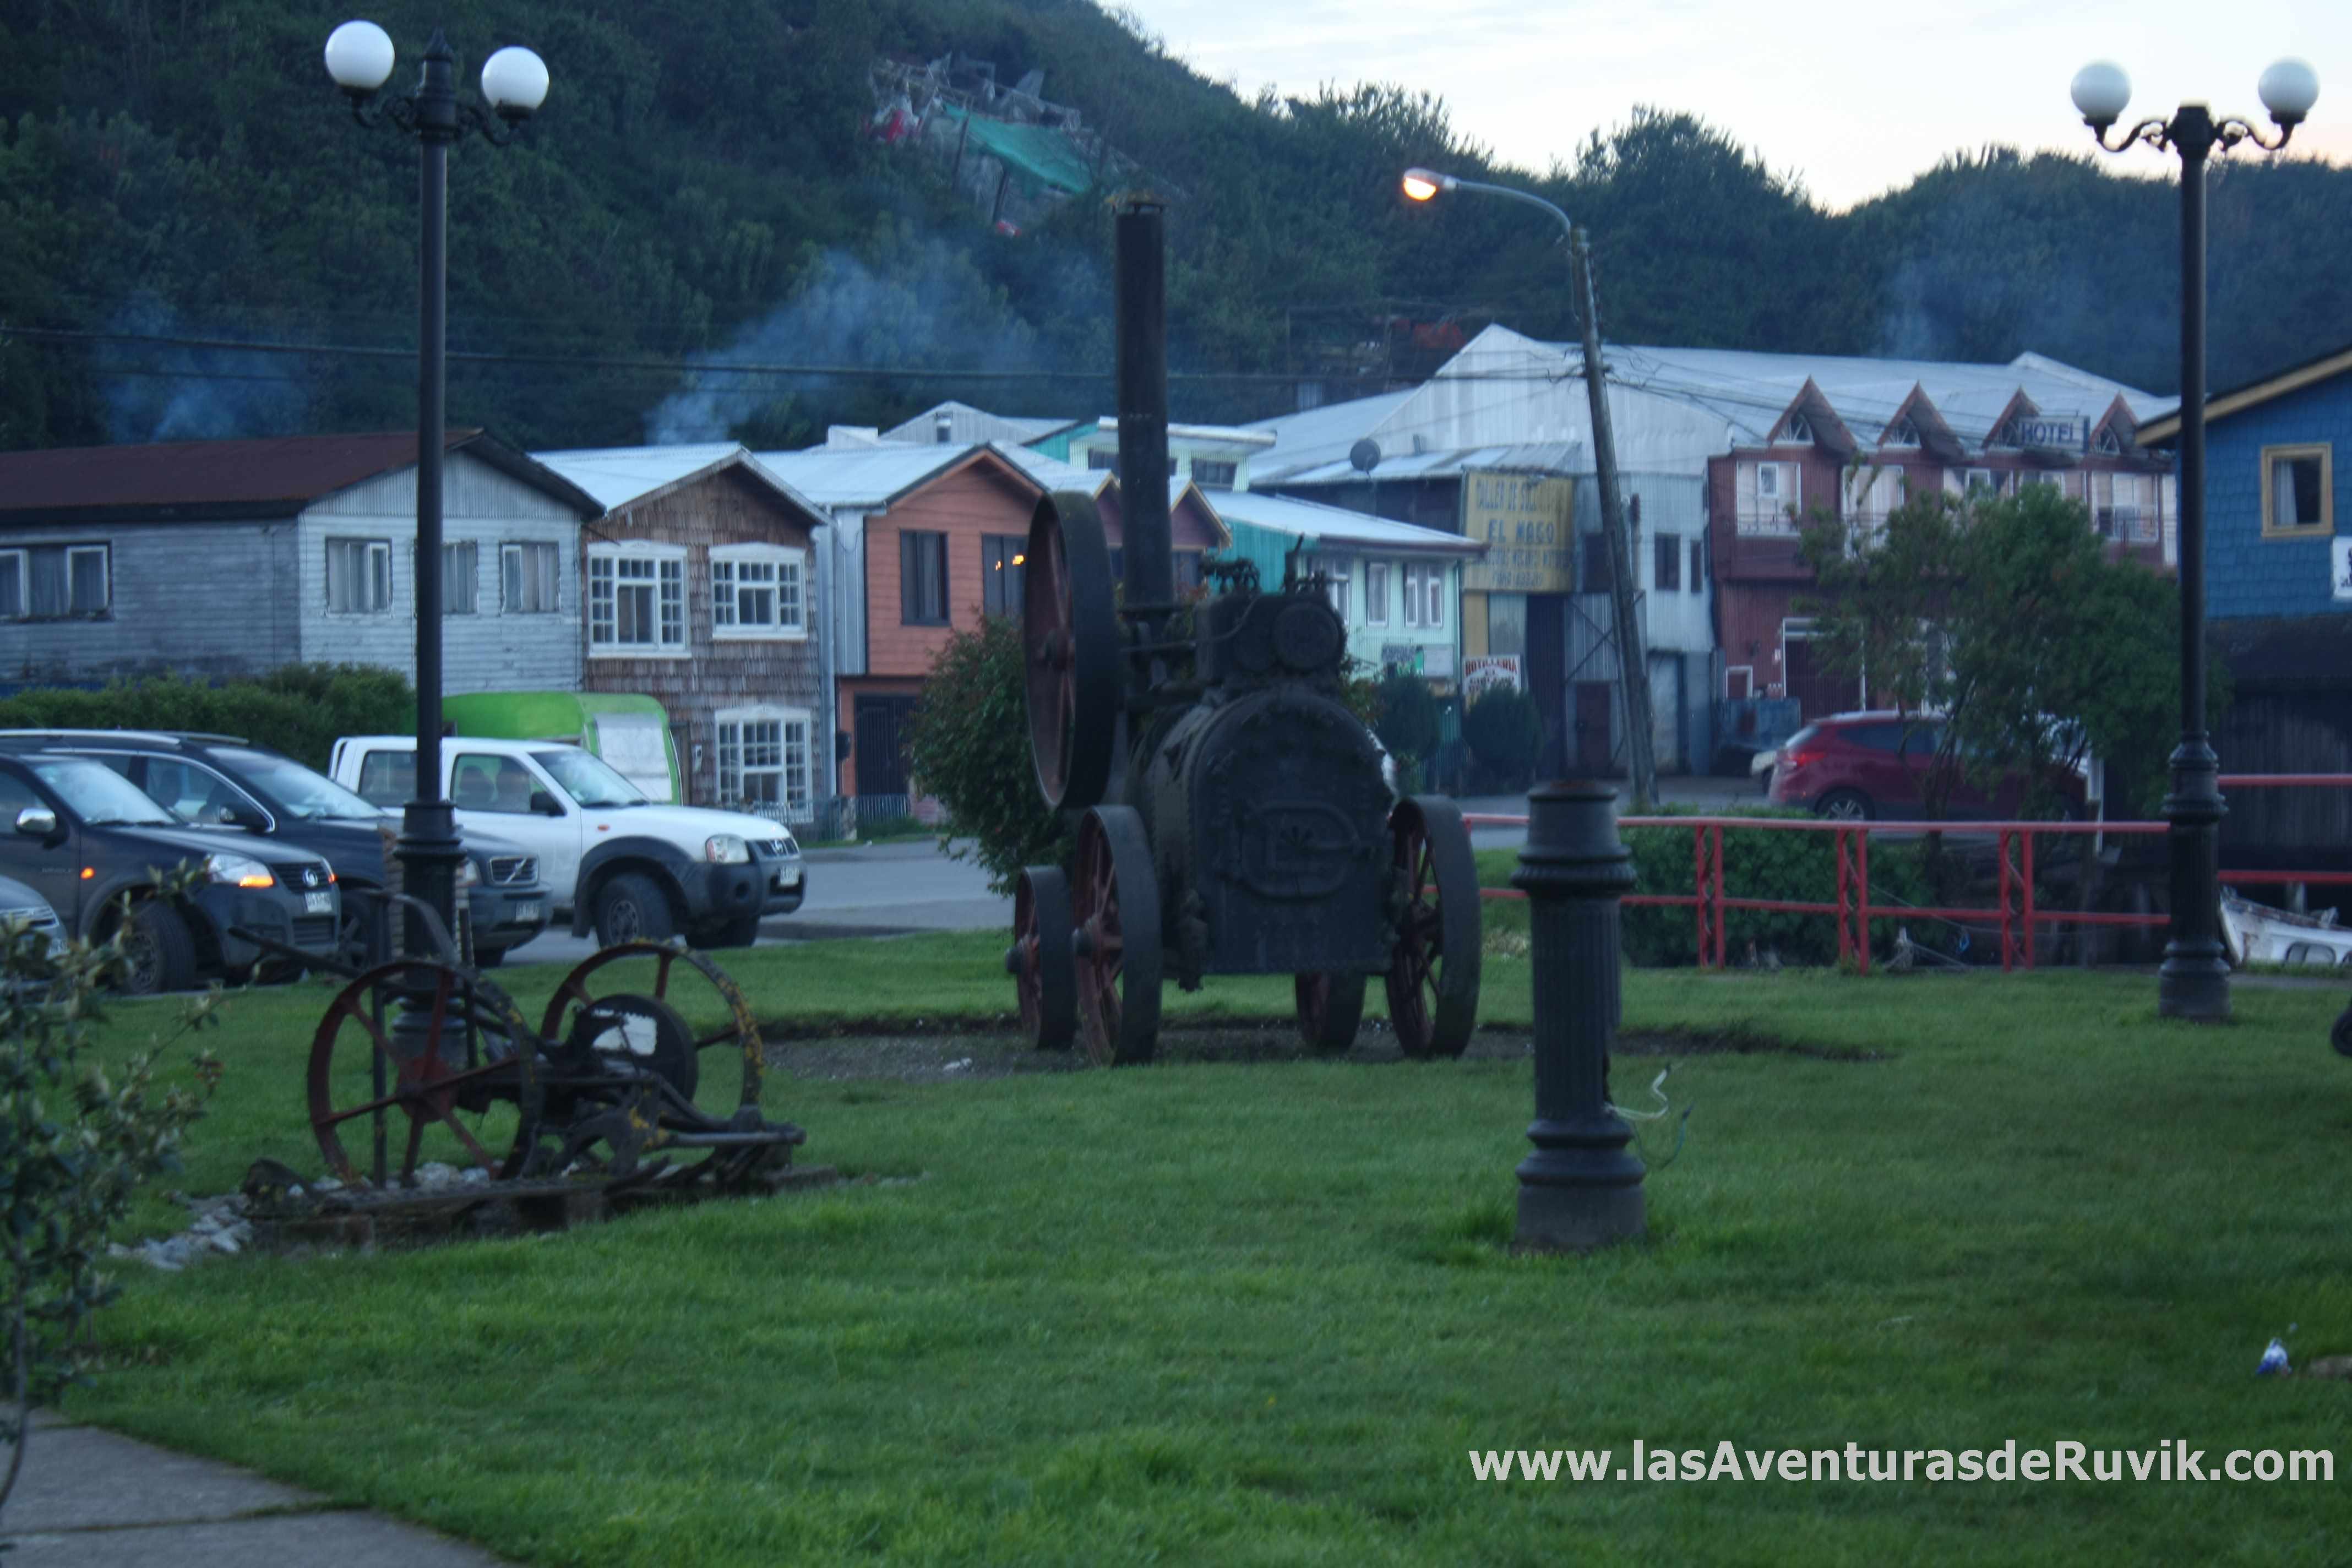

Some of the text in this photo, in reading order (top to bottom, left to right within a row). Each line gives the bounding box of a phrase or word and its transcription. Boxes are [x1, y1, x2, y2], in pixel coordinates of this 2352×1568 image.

[2021, 422, 2078, 444] HOTEL
[1488, 519, 1507, 542] EL
[1465, 658, 1517, 677] BOTILLERIA
